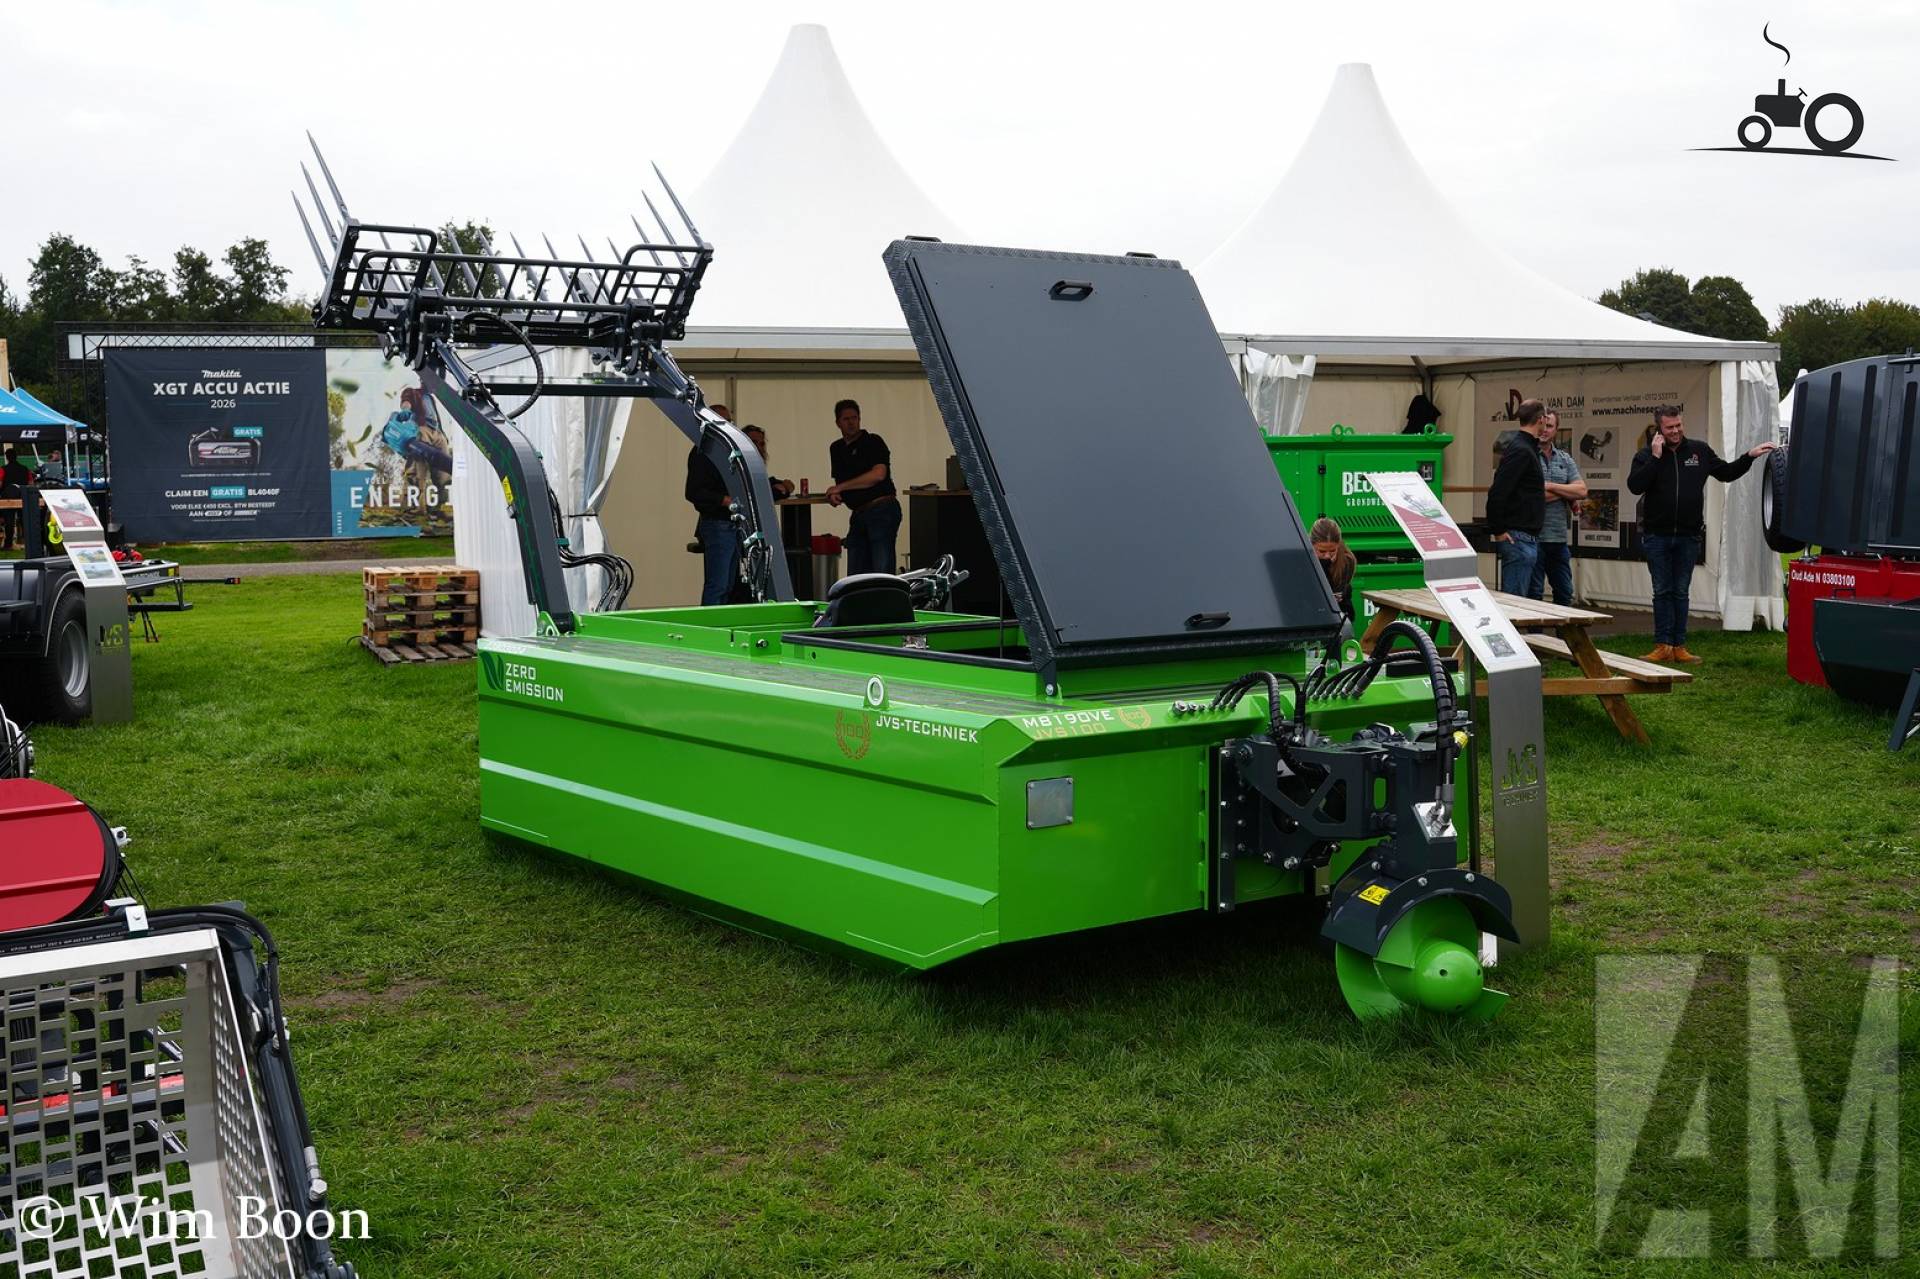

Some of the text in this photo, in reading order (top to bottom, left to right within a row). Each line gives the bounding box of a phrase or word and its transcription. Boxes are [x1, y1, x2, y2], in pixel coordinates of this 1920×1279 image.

[201, 369, 242, 379] Makita
[153, 381, 290, 396] XGT ACCU ACTIE
[210, 399, 237, 409] 2026
[1546, 395, 1585, 409] VAN DAM
[164, 489, 192, 498] CLAIM
[193, 488, 208, 497] EEN
[211, 487, 244, 497] GRATIS
[1815, 572, 1821, 583] N
[1822, 573, 1856, 587] 03803100
[505, 662, 537, 681] ZERO
[505, 679, 564, 703] EMISSION
[876, 715, 978, 743] JVS-TECHNIEK
